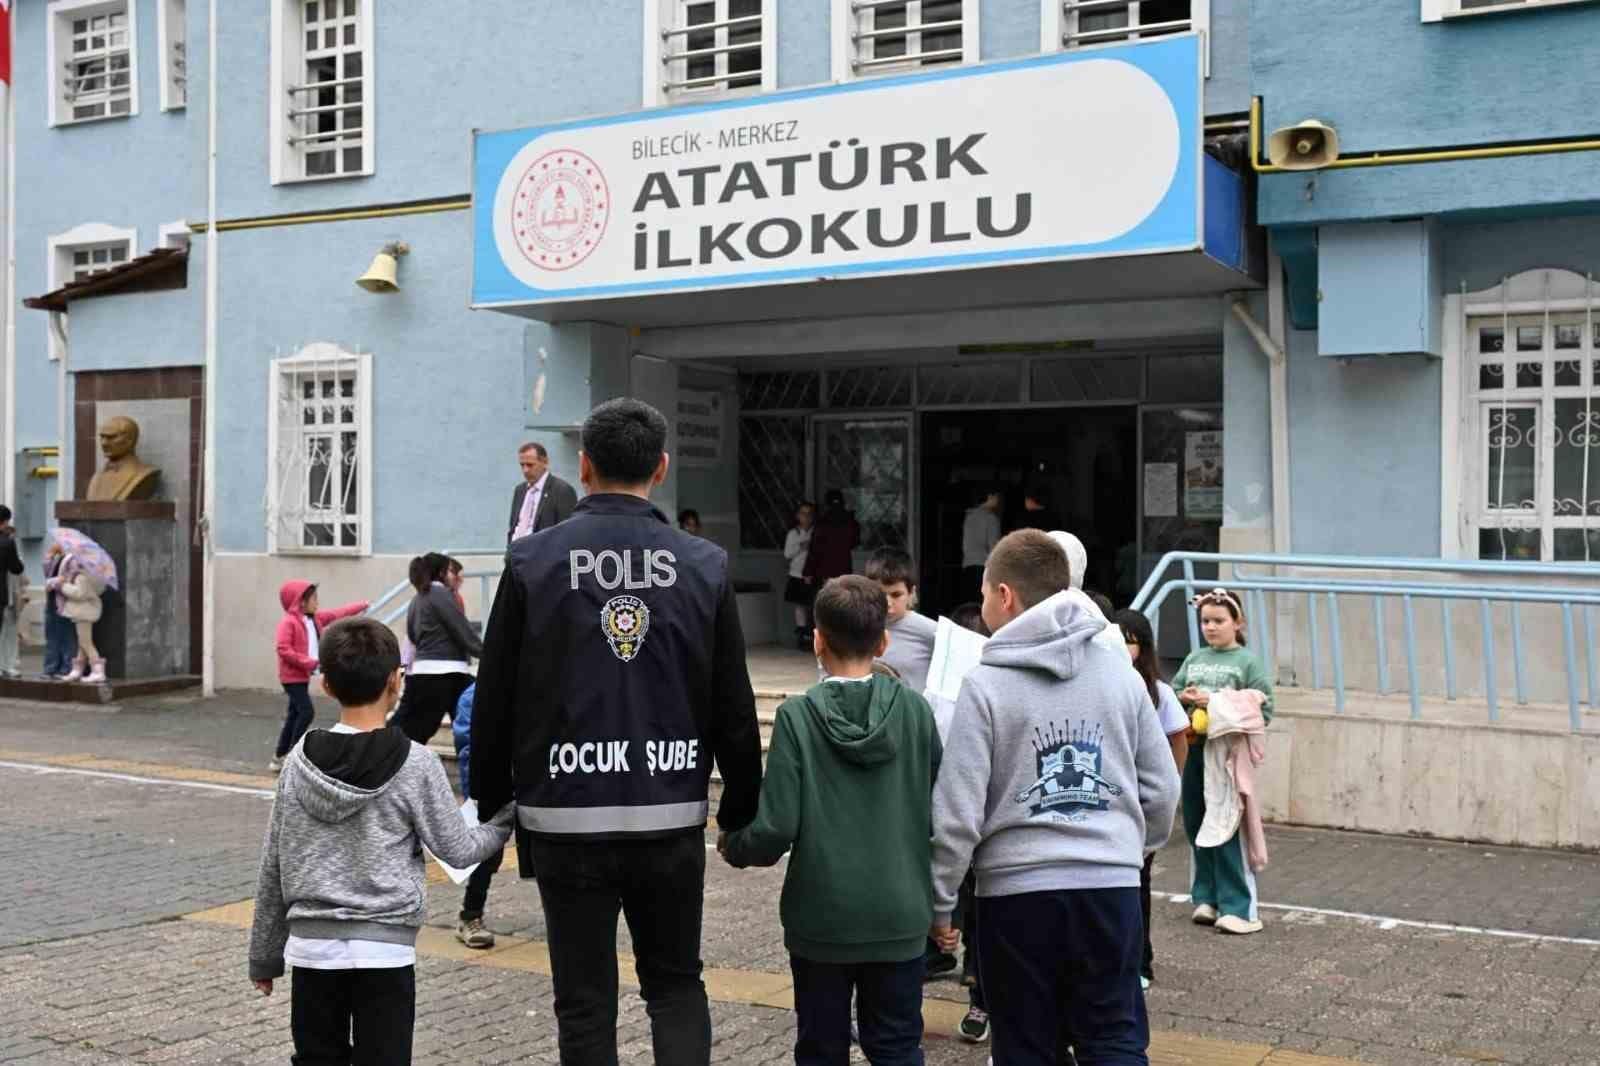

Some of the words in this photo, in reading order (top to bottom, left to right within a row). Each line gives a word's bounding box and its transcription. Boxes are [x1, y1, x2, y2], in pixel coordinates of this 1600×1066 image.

[631, 130, 702, 161] BİLECİK
[718, 119, 799, 149] MERKEZ
[632, 132, 989, 213] ATATÜRK
[633, 192, 1032, 271] İLKOKULU
[549, 741, 631, 779] ÇOCUK
[645, 739, 699, 776] ŞUBE
